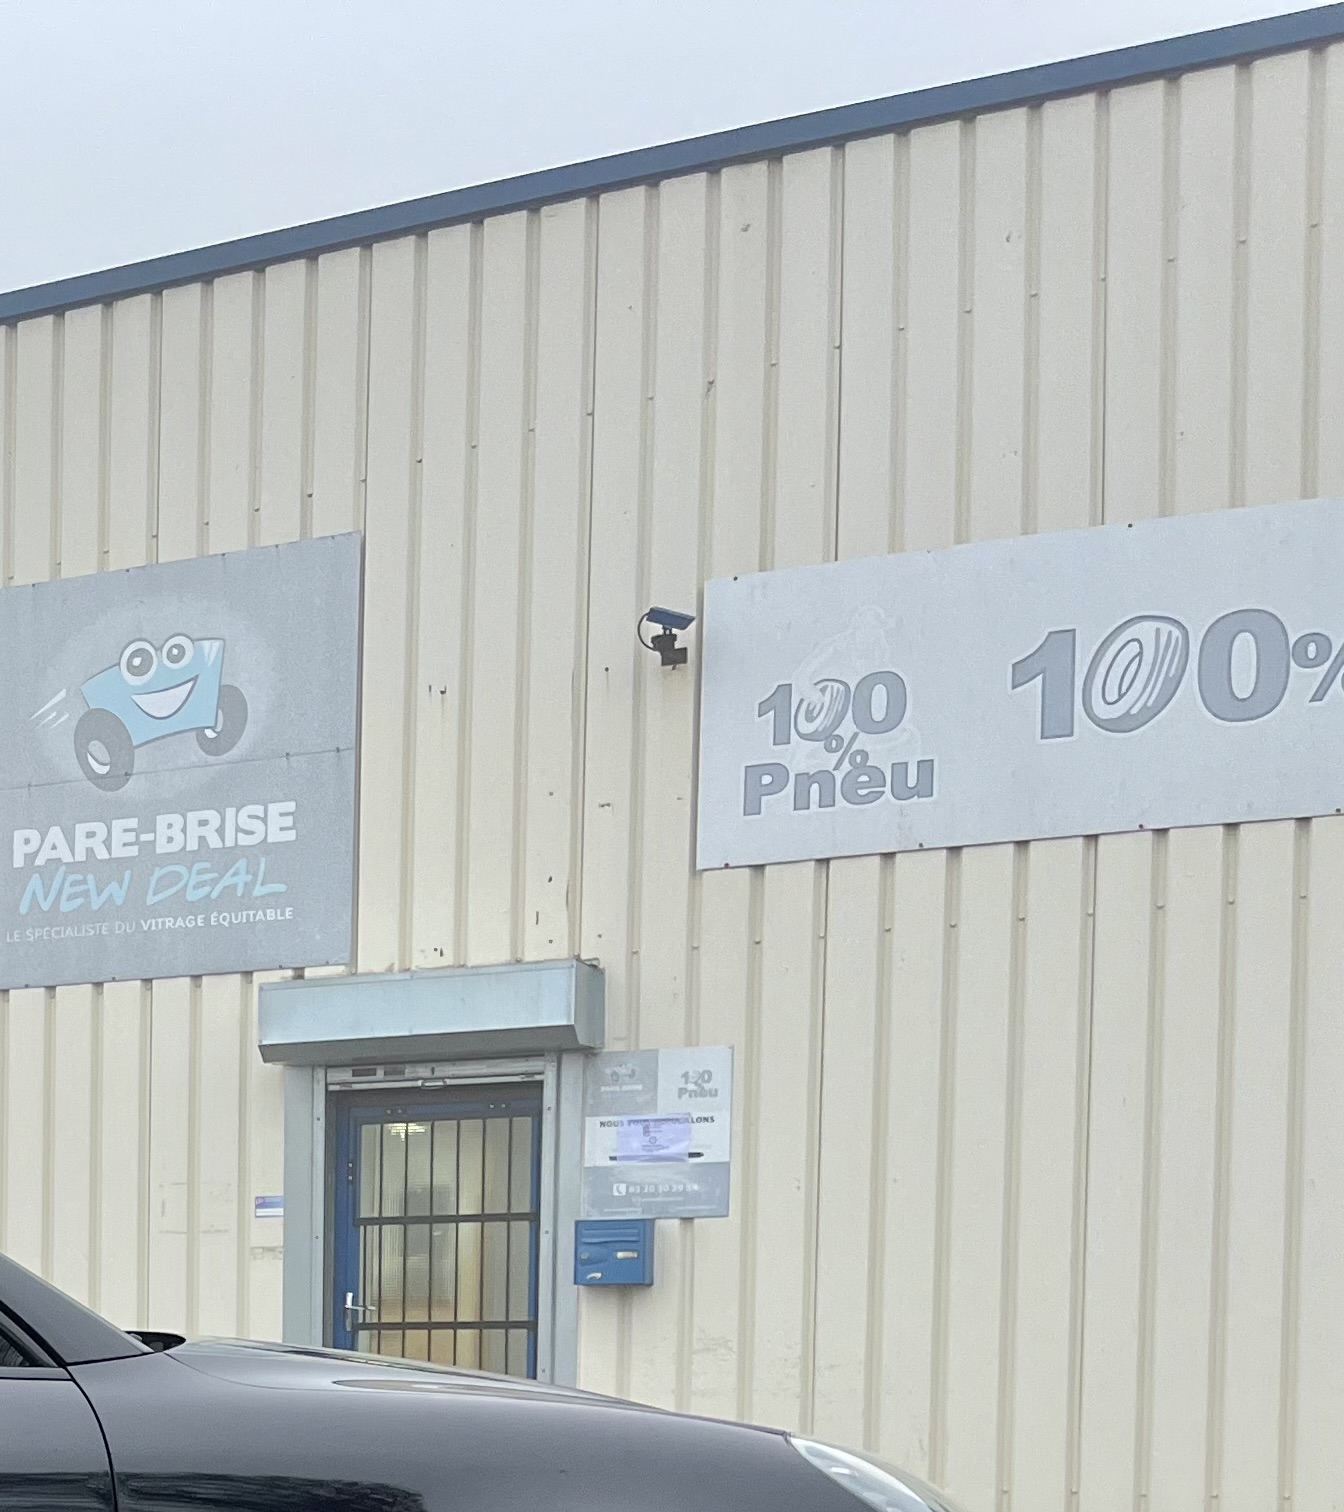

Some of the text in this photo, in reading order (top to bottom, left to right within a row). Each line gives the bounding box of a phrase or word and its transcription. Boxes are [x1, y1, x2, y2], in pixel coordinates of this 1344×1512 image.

[743, 758, 935, 817] Pneu
[12, 800, 297, 869] PARE-BRISE
[18, 857, 288, 915] NEW DEAL
[6, 929, 22, 943] LE
[114, 920, 137, 935] DU
[139, 913, 206, 932] VITRAGE
[210, 906, 294, 928] ÉQUITABLE
